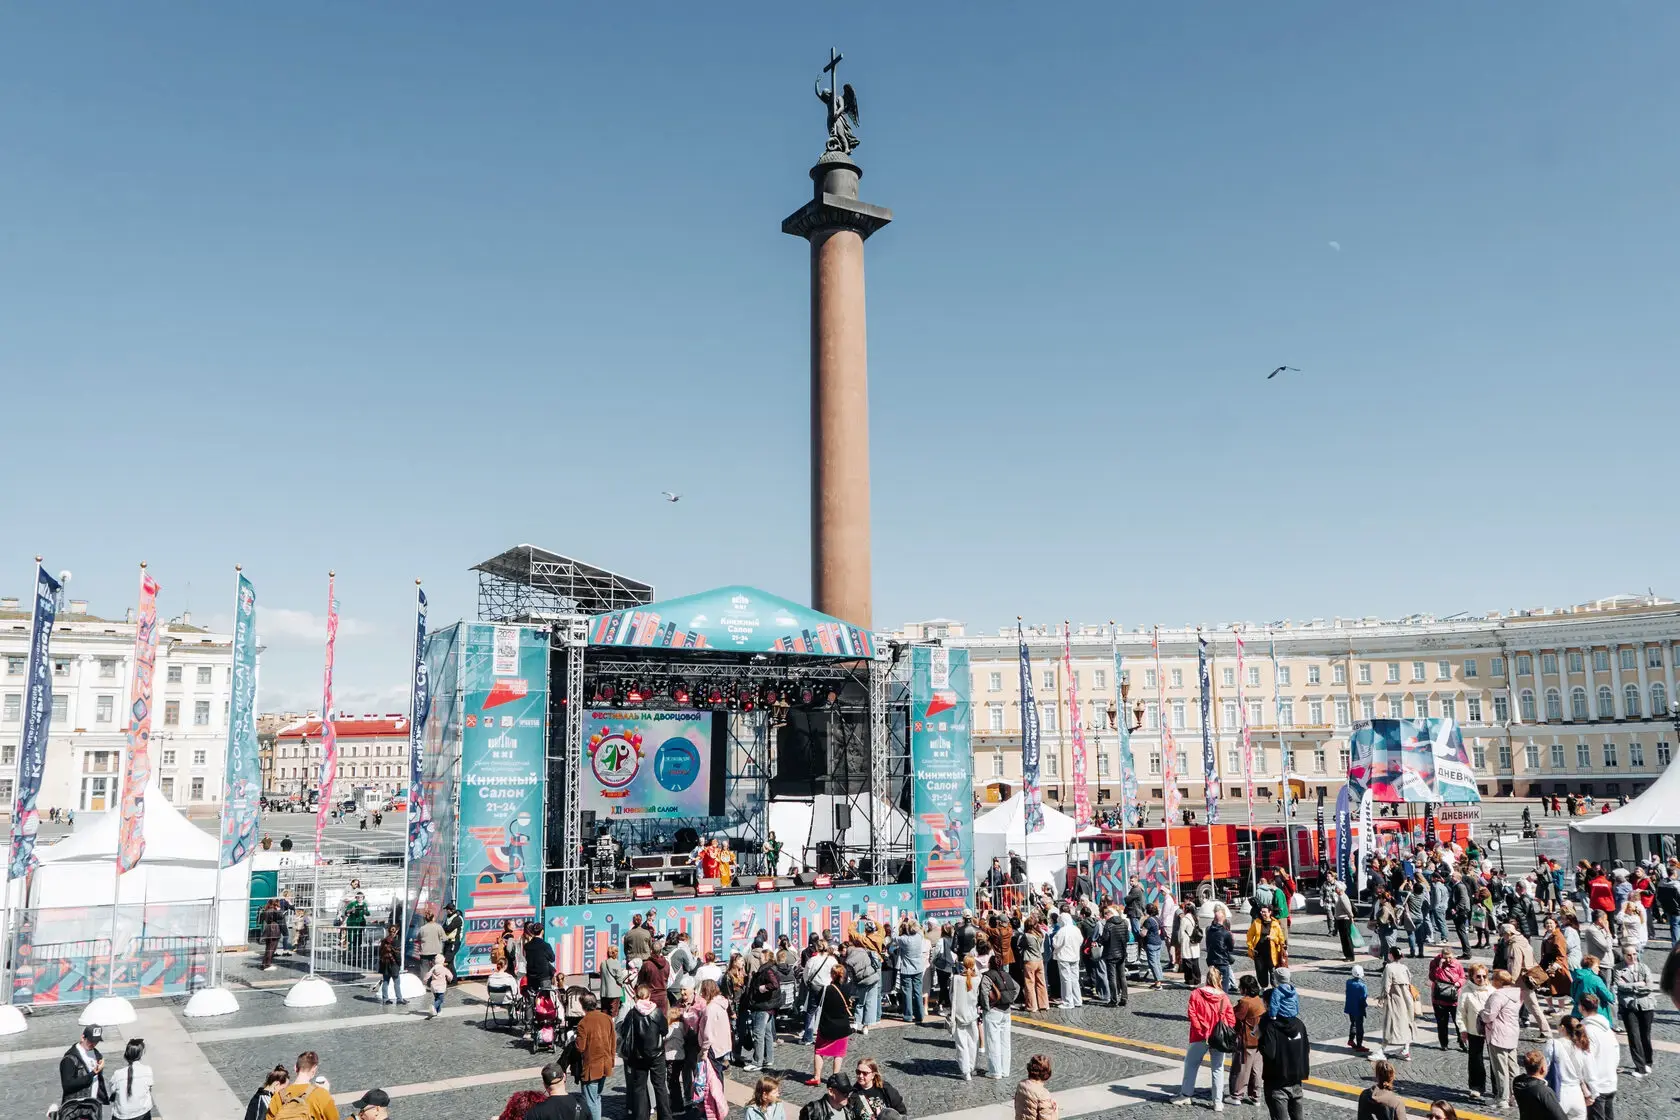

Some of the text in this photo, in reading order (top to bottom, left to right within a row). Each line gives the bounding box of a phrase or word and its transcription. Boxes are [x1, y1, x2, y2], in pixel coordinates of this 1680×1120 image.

[720, 617, 760, 627] Книжный
[728, 625, 753, 633] Салон
[641, 712, 652, 720] НА
[654, 711, 701, 722] ДВОРЦОВОЙ
[466, 772, 538, 786] Книжный
[917, 767, 966, 780] Книжный
[1438, 767, 1474, 784] ДНЕВН
[926, 781, 958, 790] Салон
[478, 786, 525, 799] Салон
[1441, 810, 1480, 821] ДНЕВНИК
